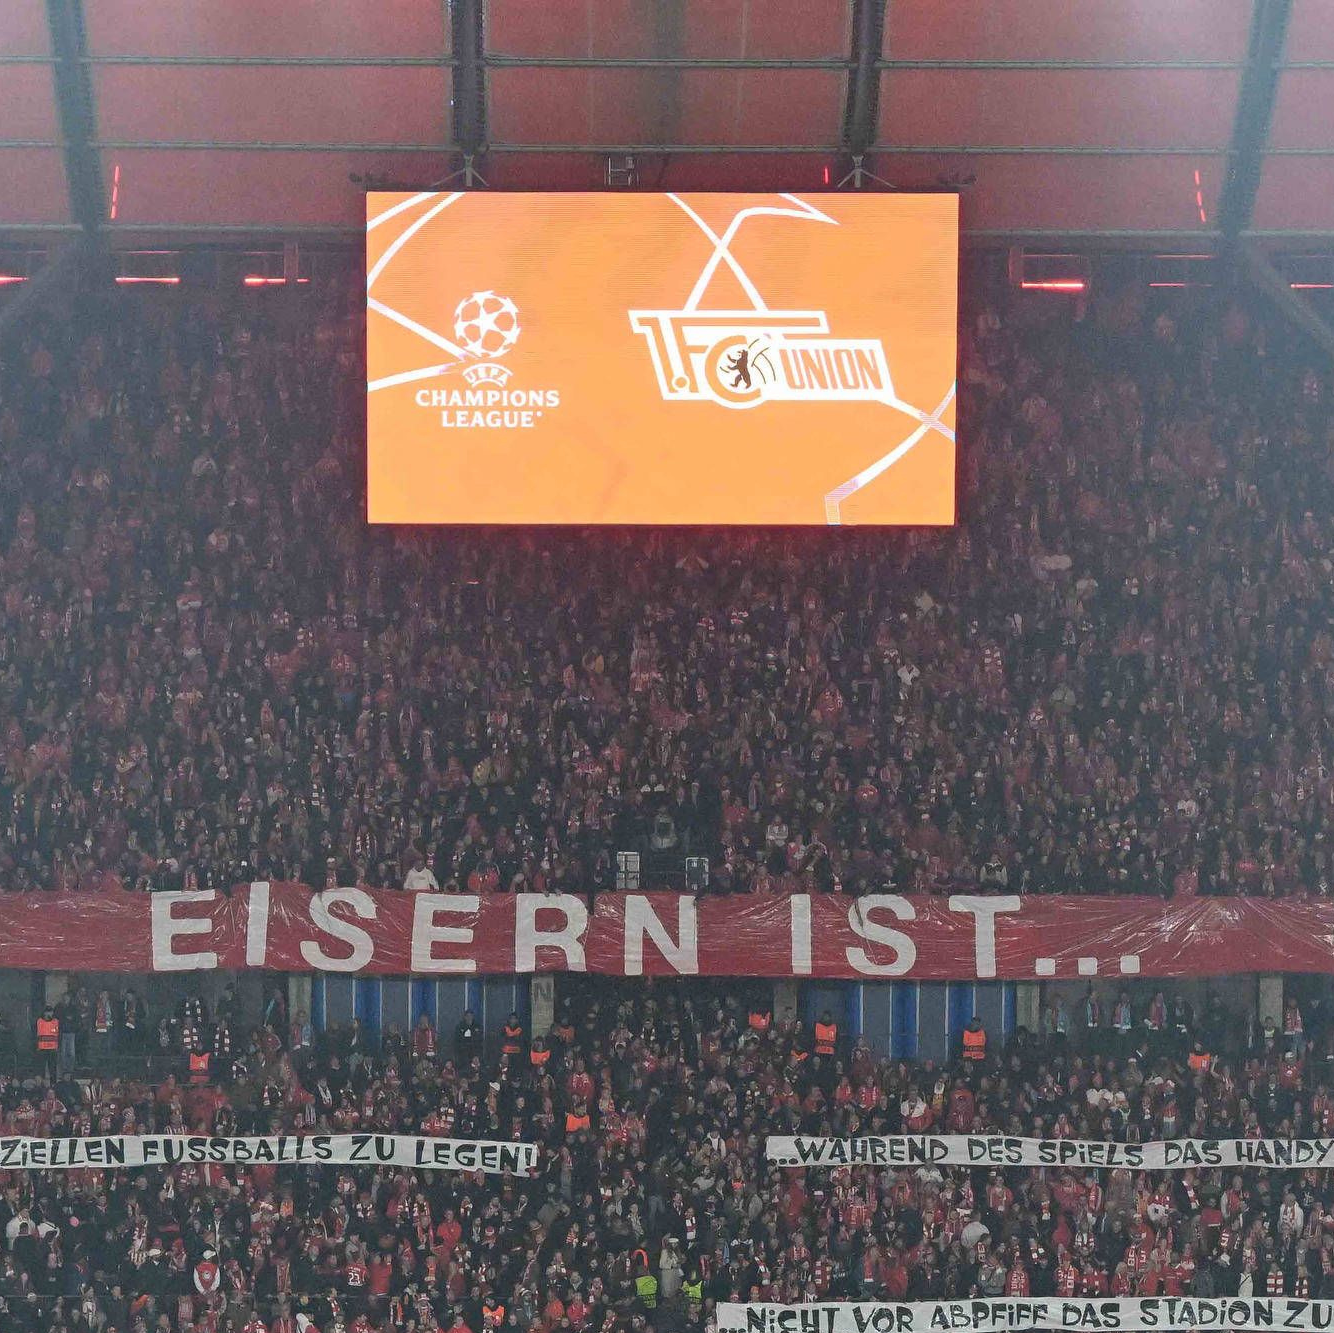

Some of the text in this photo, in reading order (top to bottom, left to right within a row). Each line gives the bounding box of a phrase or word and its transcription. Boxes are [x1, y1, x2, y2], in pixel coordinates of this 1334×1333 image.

[779, 348, 883, 390] UNION
[415, 389, 560, 407] CHAMPIONS
[442, 410, 537, 427] LEAGUE
[151, 881, 1140, 978] EISERN IST...
[143, 1136, 332, 1164] FUSSBALLS
[349, 1135, 396, 1161] ZU
[415, 1139, 534, 1177] LEGEN!
[968, 1137, 1023, 1162] DES
[1164, 1140, 1223, 1165] DAS
[1235, 1139, 1334, 1165] HANDY
[853, 1305, 914, 1333] VOR
[1062, 1302, 1120, 1328] DAS
[1283, 1301, 1333, 1329] ZU
